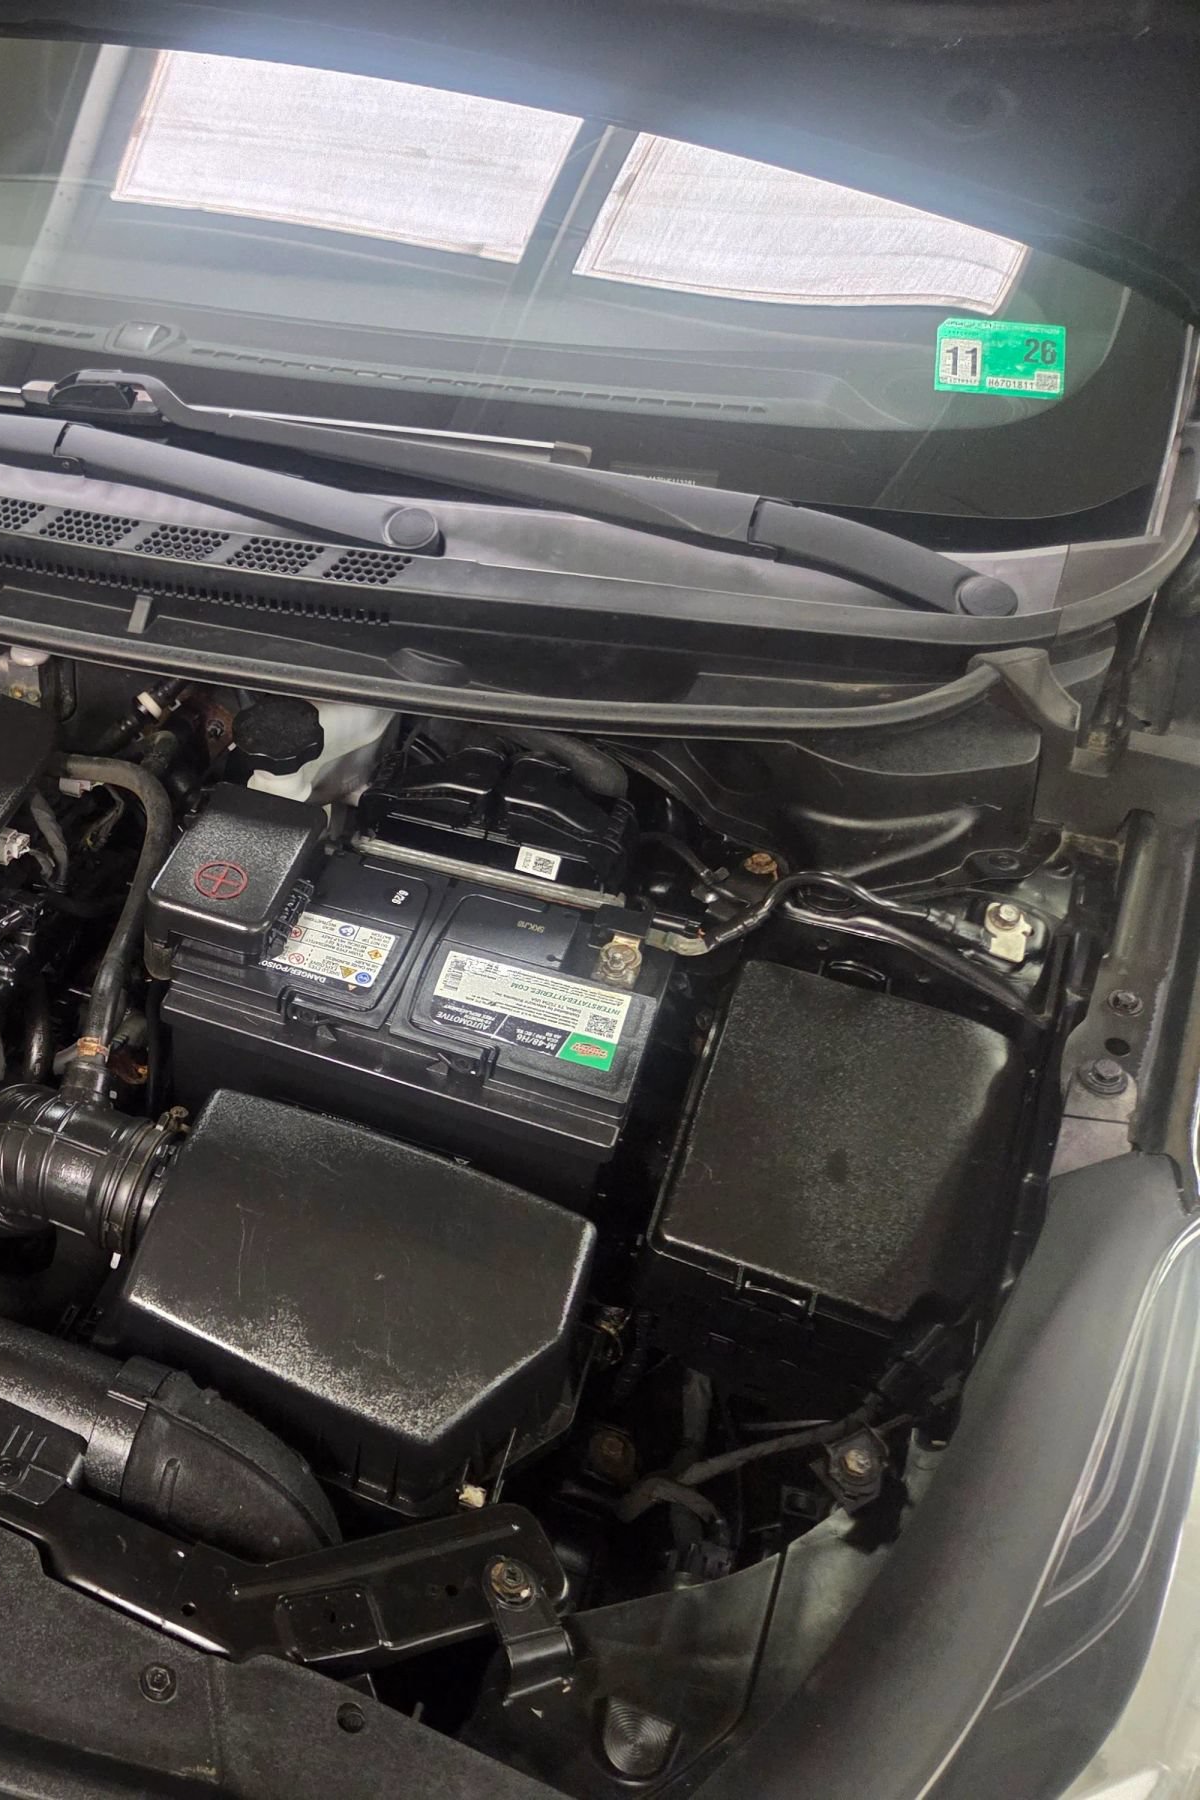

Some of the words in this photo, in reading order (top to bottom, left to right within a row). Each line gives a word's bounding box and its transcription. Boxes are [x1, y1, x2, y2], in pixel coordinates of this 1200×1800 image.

[946, 346, 978, 377] 11
[1024, 338, 1057, 365] 26
[391, 890, 410, 904] 6/26
[510, 981, 621, 1016] INTERSTATEBATTERIES.COM
[436, 1011, 490, 1030] AUTOMOTIVE
[515, 1034, 556, 1050] M-48/H6
